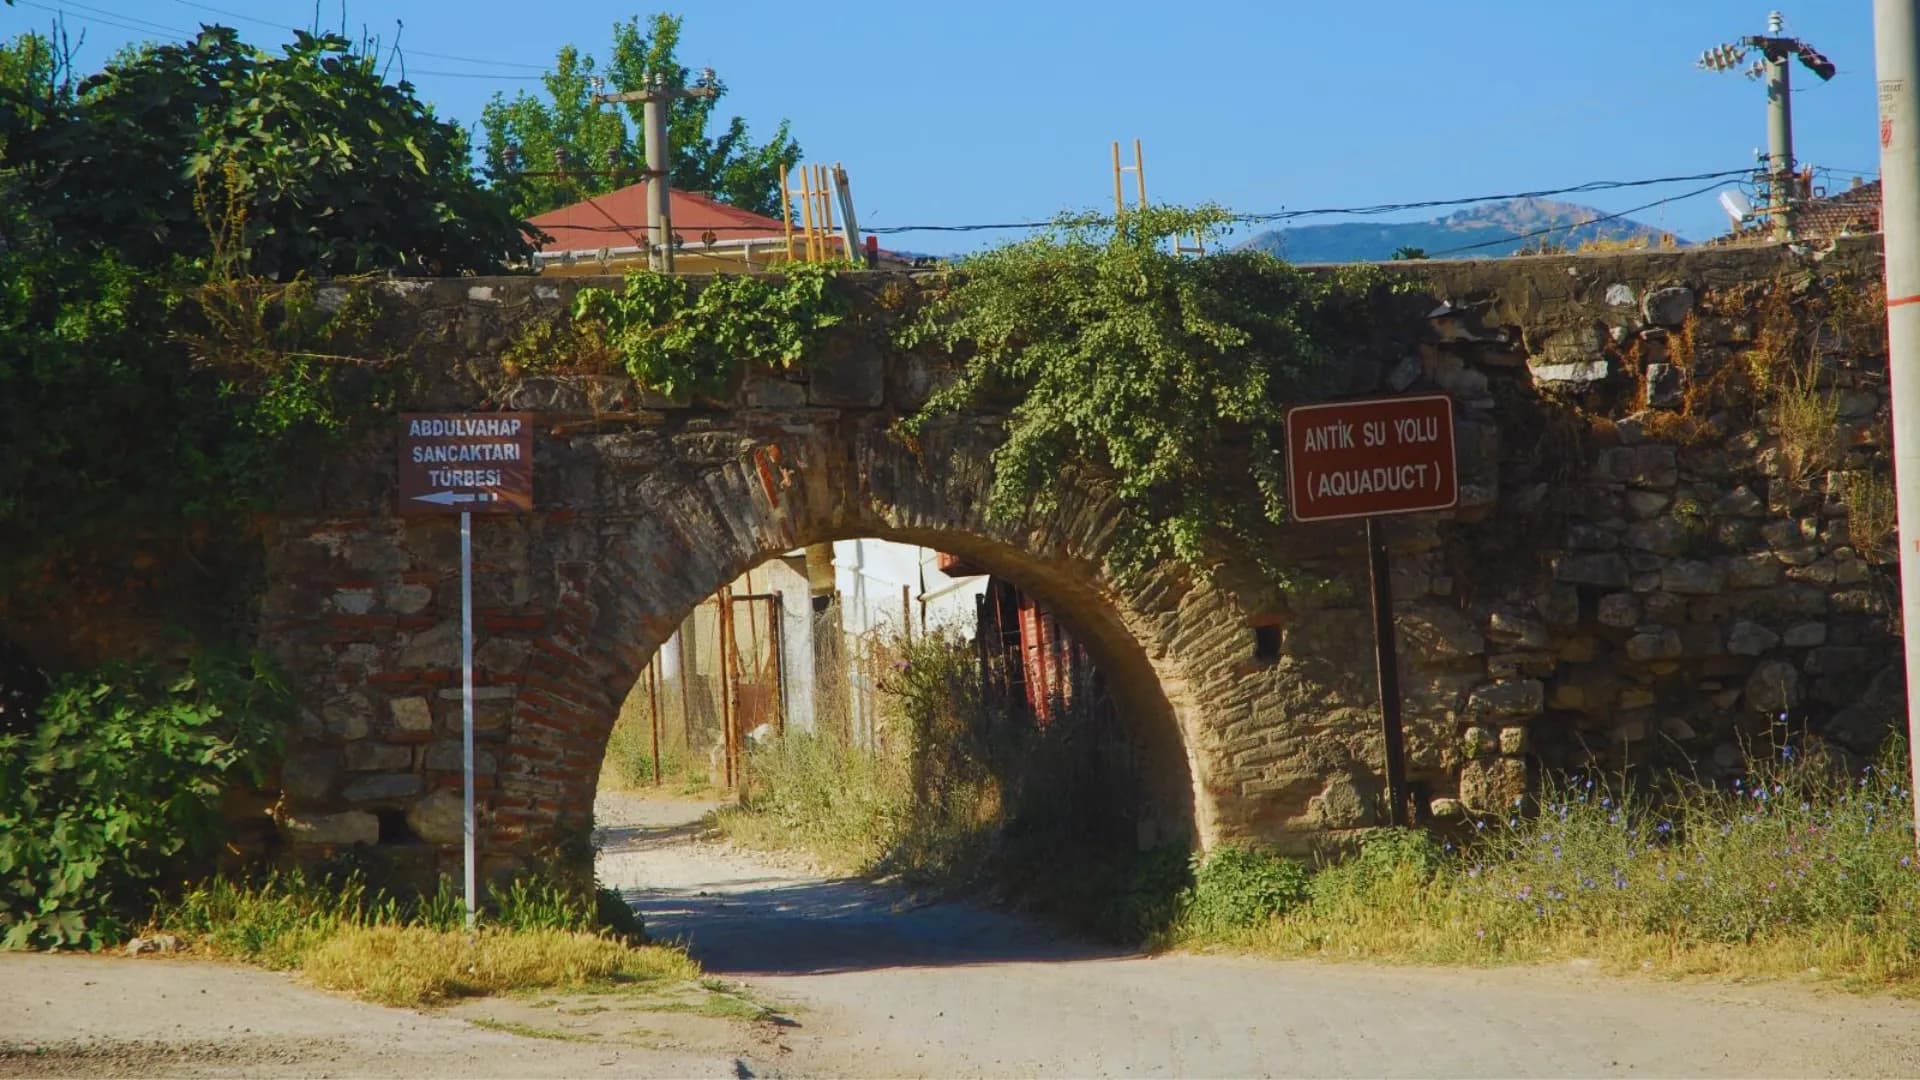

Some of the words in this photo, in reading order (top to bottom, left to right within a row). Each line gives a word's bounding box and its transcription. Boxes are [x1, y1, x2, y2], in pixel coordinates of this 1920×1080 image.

[409, 419, 521, 436] ABDULVAHAP
[1304, 419, 1355, 452] ANTİK
[1363, 421, 1386, 447] SU
[1394, 416, 1438, 443] YOLU
[412, 443, 520, 462] SANCAKTARI
